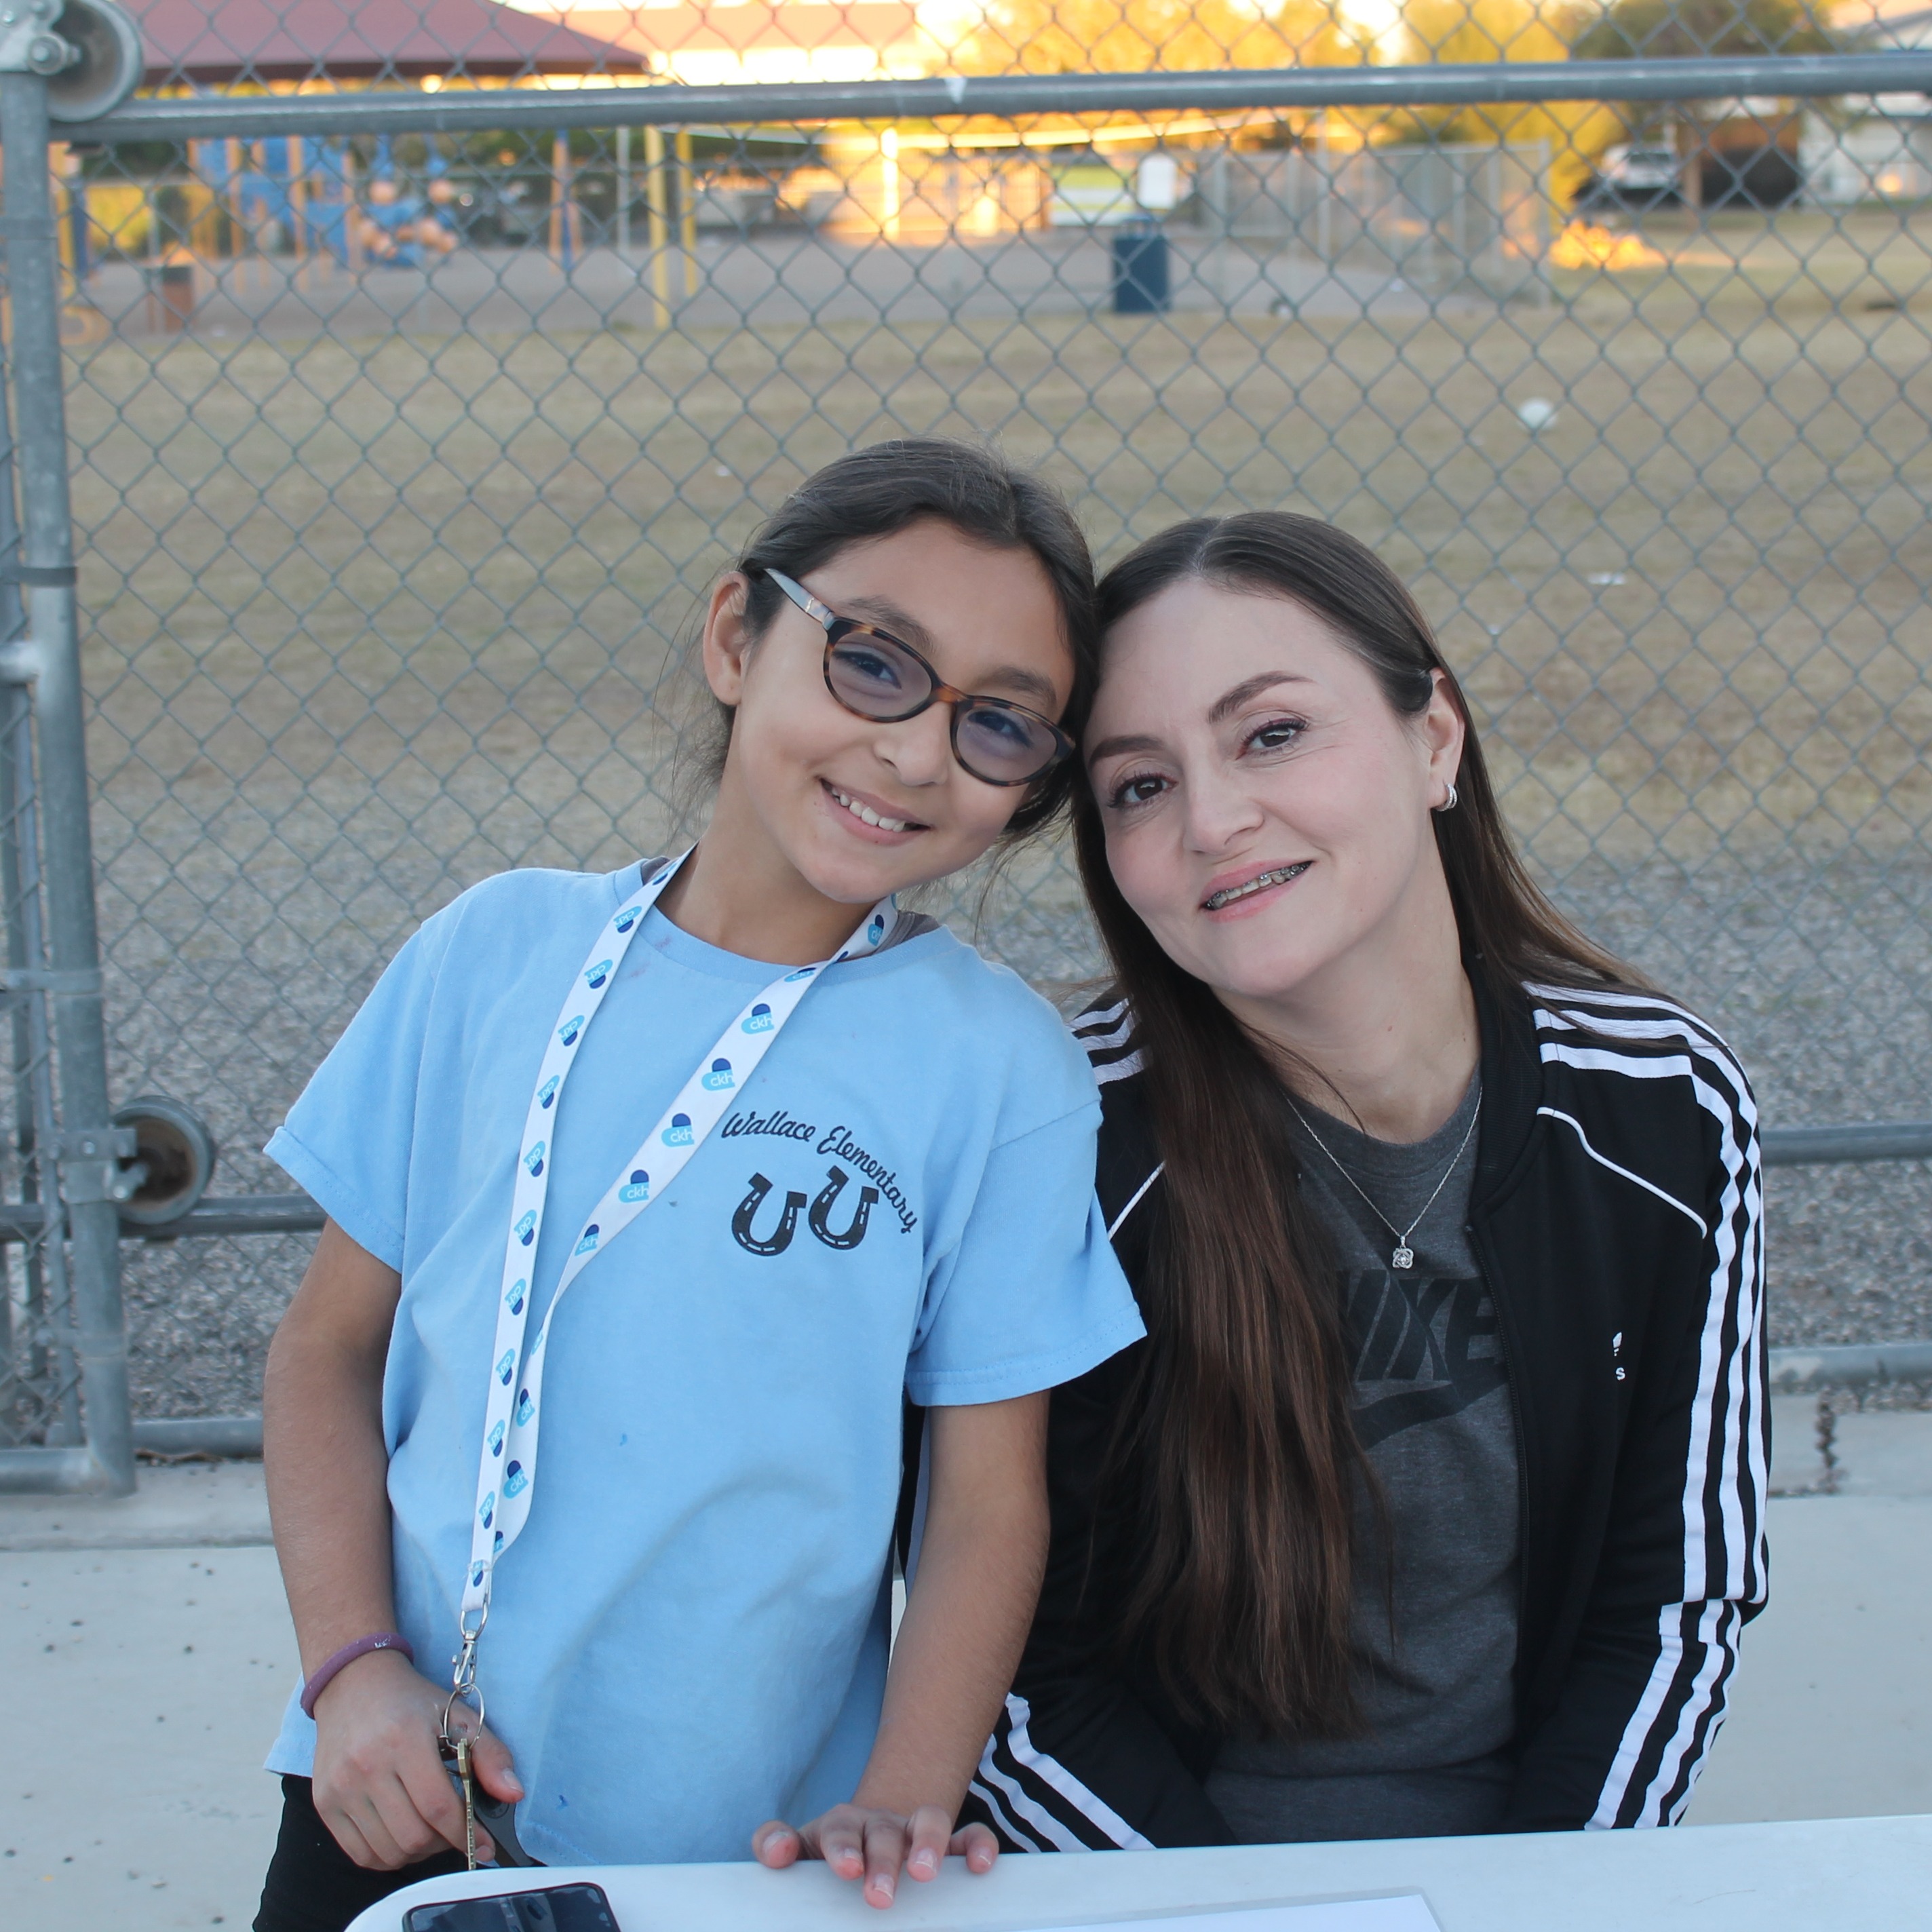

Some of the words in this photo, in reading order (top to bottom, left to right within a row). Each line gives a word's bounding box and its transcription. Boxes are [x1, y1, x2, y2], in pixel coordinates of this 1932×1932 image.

[587, 965, 605, 980] ckh
[560, 1021, 577, 1038] ckh
[750, 1018, 773, 1030] ckh
[710, 1073, 733, 1085] ckh
[670, 1130, 692, 1142] ckh
[721, 1110, 816, 1142] Wallace
[816, 1125, 917, 1234] Elementary
[627, 1185, 649, 1198] ckh
